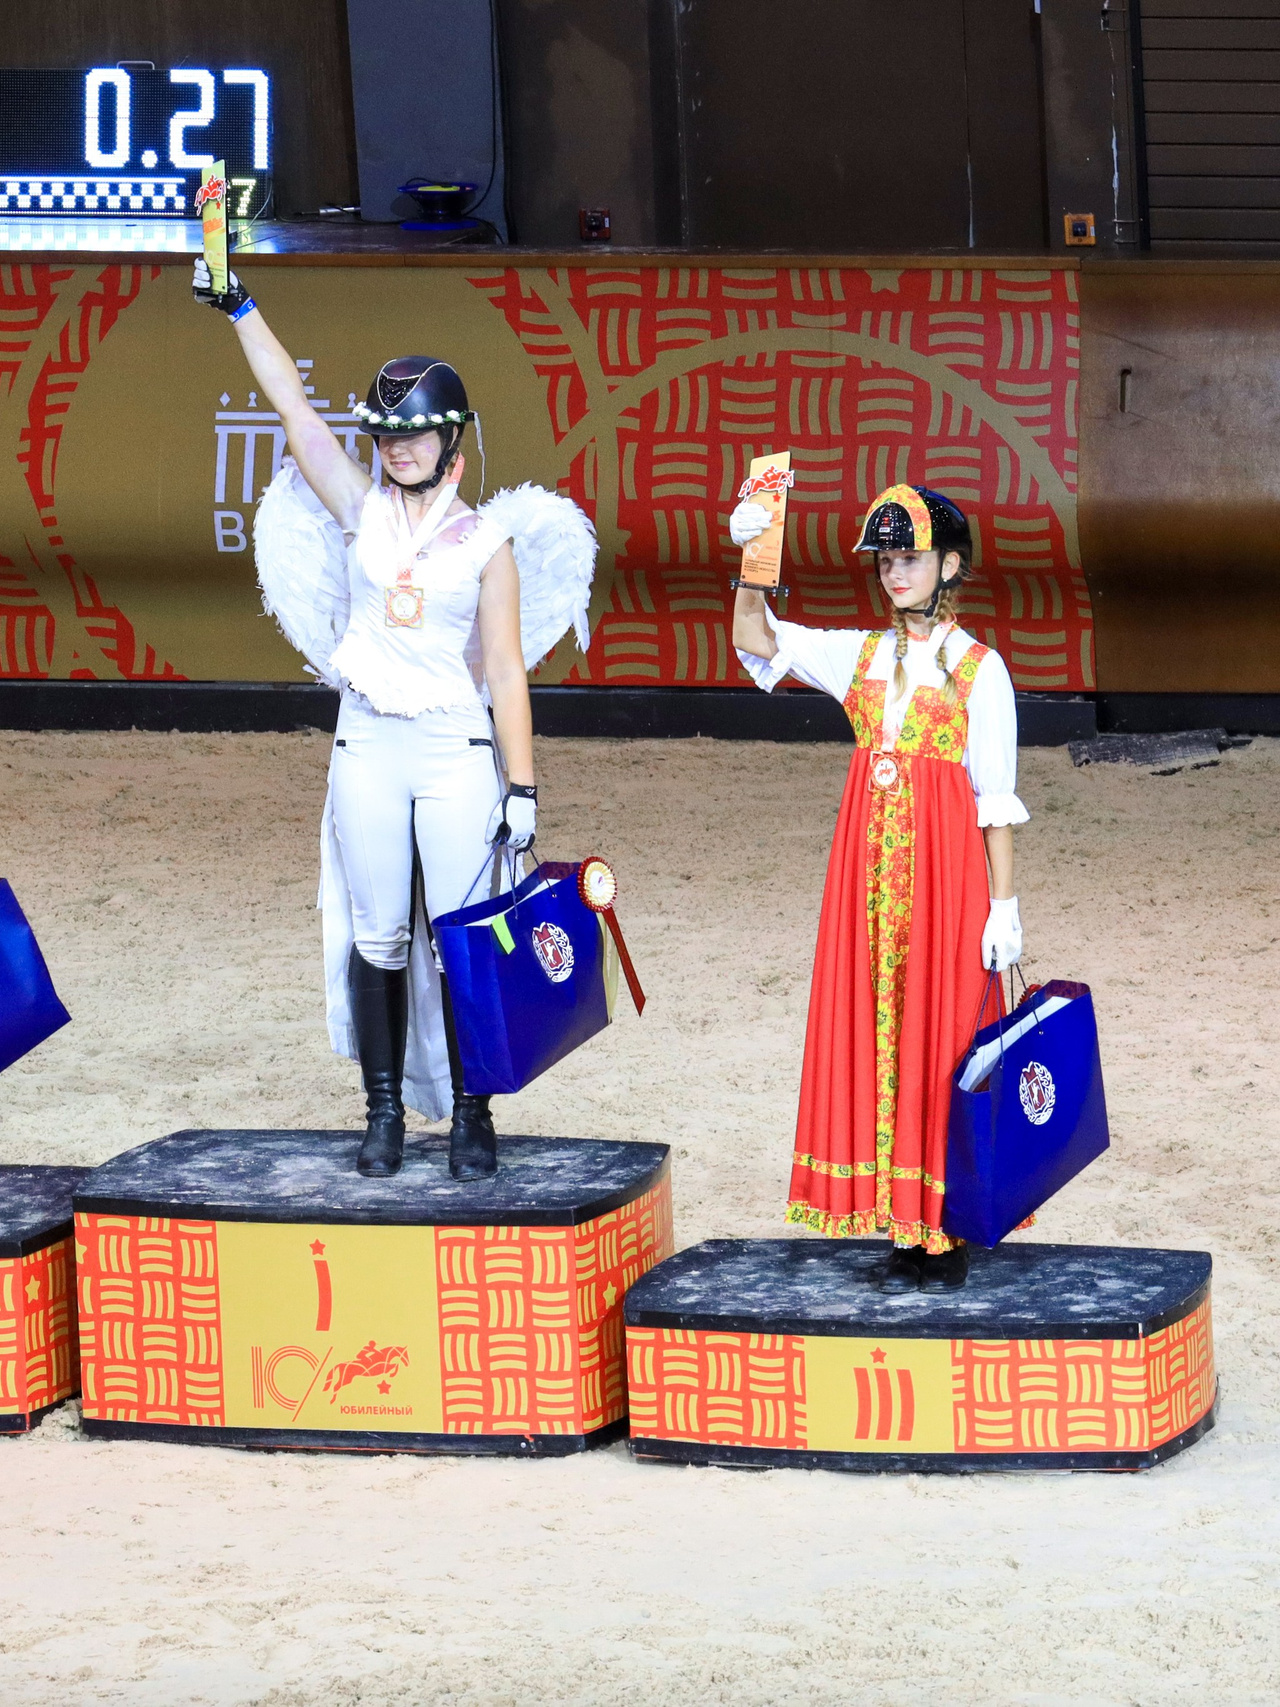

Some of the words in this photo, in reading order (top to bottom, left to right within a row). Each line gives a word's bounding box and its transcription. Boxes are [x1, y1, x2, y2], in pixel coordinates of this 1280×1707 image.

[85, 69, 269, 169] 0.27
[226, 179, 256, 216] 7
[340, 1404, 413, 1416] ЮБИЛЕЙНЫЙ
